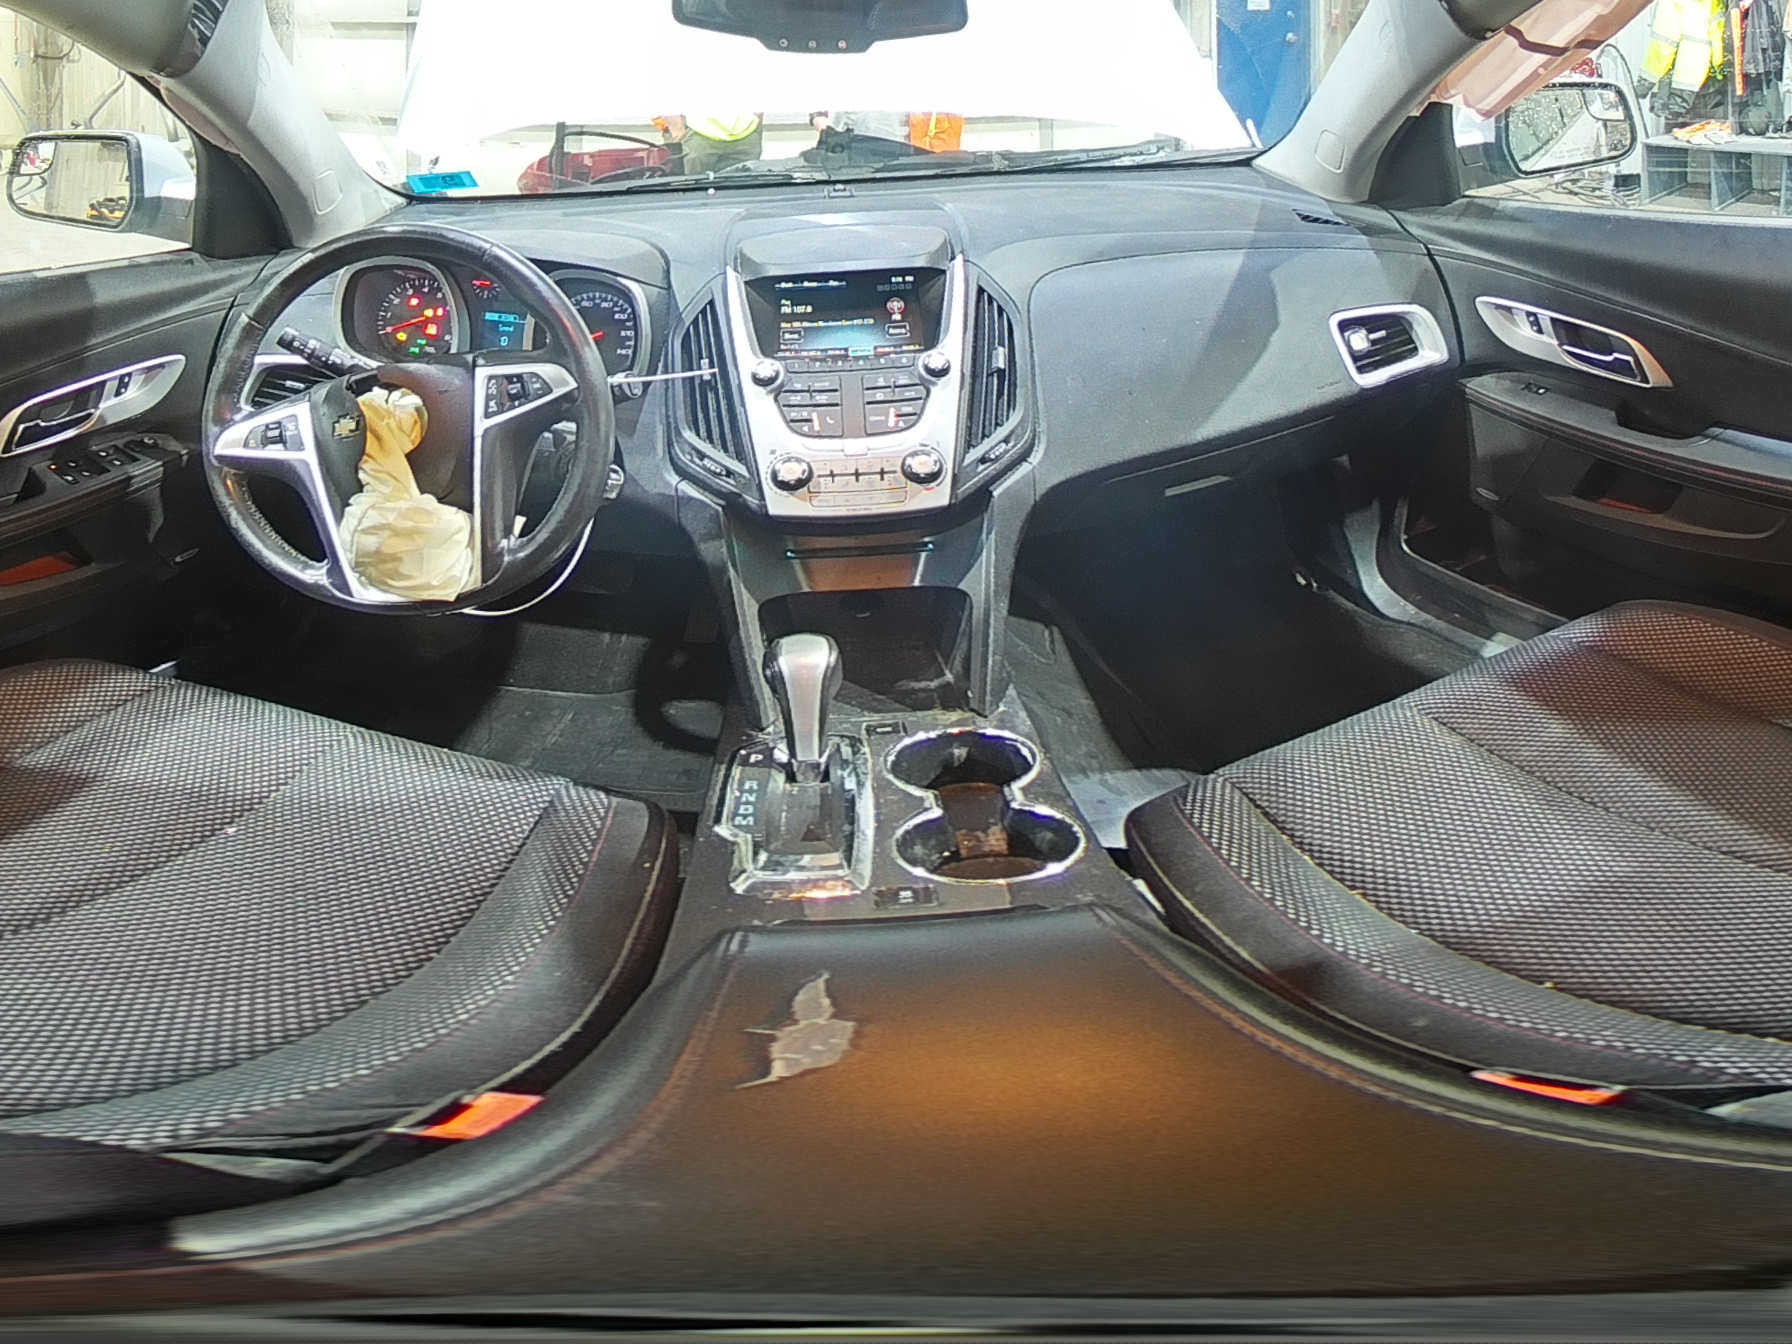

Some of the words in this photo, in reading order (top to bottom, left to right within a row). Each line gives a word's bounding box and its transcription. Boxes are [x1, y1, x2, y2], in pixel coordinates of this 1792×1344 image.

[749, 753, 764, 763] P
[744, 780, 758, 790] R
[741, 793, 757, 802] N
[738, 805, 754, 814] D
